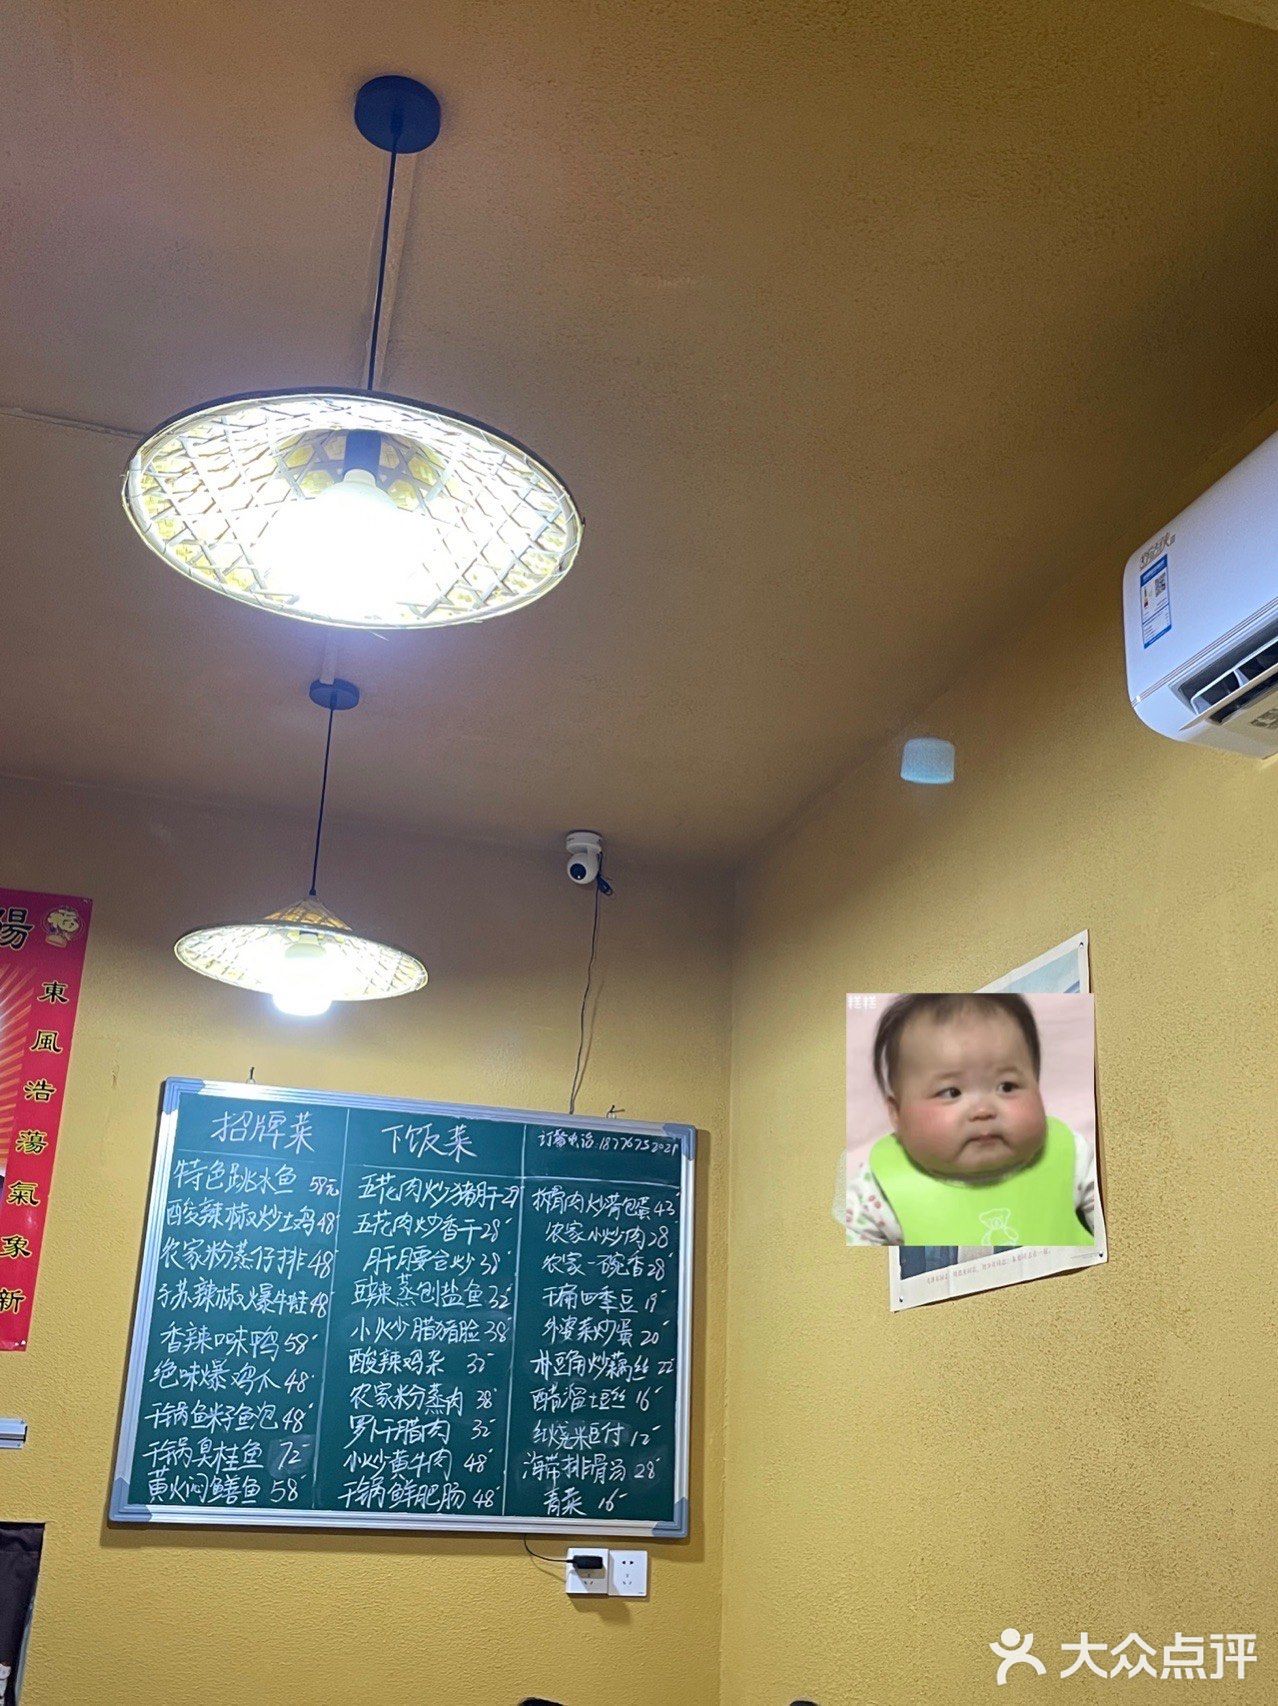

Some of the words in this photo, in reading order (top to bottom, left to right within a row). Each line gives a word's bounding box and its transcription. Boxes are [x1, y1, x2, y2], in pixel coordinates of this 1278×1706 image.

[211, 1110, 314, 1154] 招牌菜
[381, 1123, 477, 1163] 下饭菜
[174, 1159, 297, 1194] 特色跳水鱼
[358, 1172, 504, 1210] 五花肉炒猪肝
[167, 1198, 315, 1236] 酸辣椒炒土鸡
[353, 1210, 481, 1245] 五花肉炒香干
[545, 1221, 646, 1250] 农家小炒肉
[160, 1236, 308, 1280] 农家粉蒸仔排
[363, 1244, 476, 1276] 肝腰合炒
[541, 1251, 645, 1278] 农家一碗香
[160, 1321, 280, 1361] 香辣口味鸭
[351, 1316, 480, 1344] 小炒腊猪脸
[541, 1315, 633, 1347] 外婆菜炒蛋
[349, 1348, 445, 1376] 酸辣鸡杂
[145, 1400, 278, 1433] 干锅鱼籽鱼泡
[350, 1382, 464, 1417] 农家粉蒸肉
[530, 1384, 626, 1414] 醋溜土豆丝
[142, 1437, 264, 1474] 干锅臭桂鱼
[343, 1448, 452, 1481] 小炒黄牛肉
[522, 1452, 626, 1486] 海带排骨汤
[338, 1475, 466, 1511] 干锅鲜肥肠
